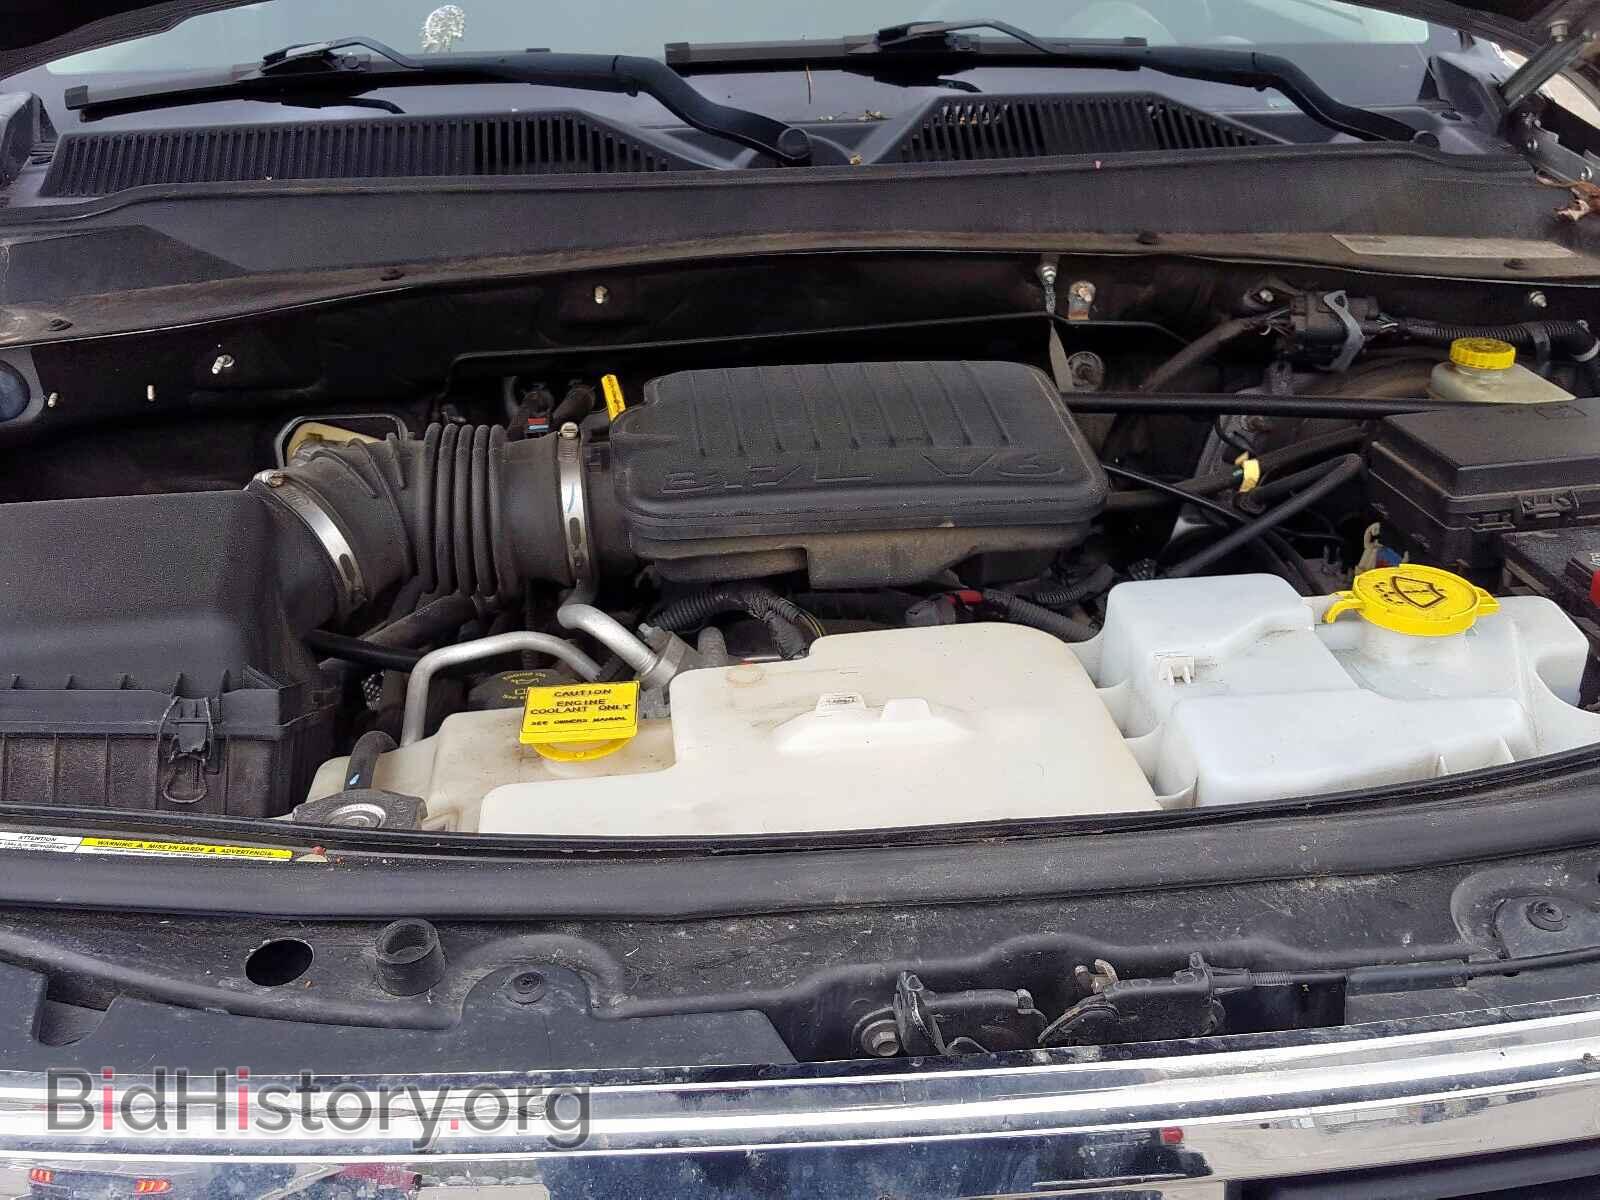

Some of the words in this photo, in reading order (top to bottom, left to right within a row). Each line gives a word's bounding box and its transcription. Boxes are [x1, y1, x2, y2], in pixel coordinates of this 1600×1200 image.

[553, 688, 612, 698] CAUTION
[556, 698, 608, 707] ENGINE
[530, 705, 589, 715] COOLANT
[598, 703, 633, 712] ONLY
[97, 839, 133, 848] WARNING
